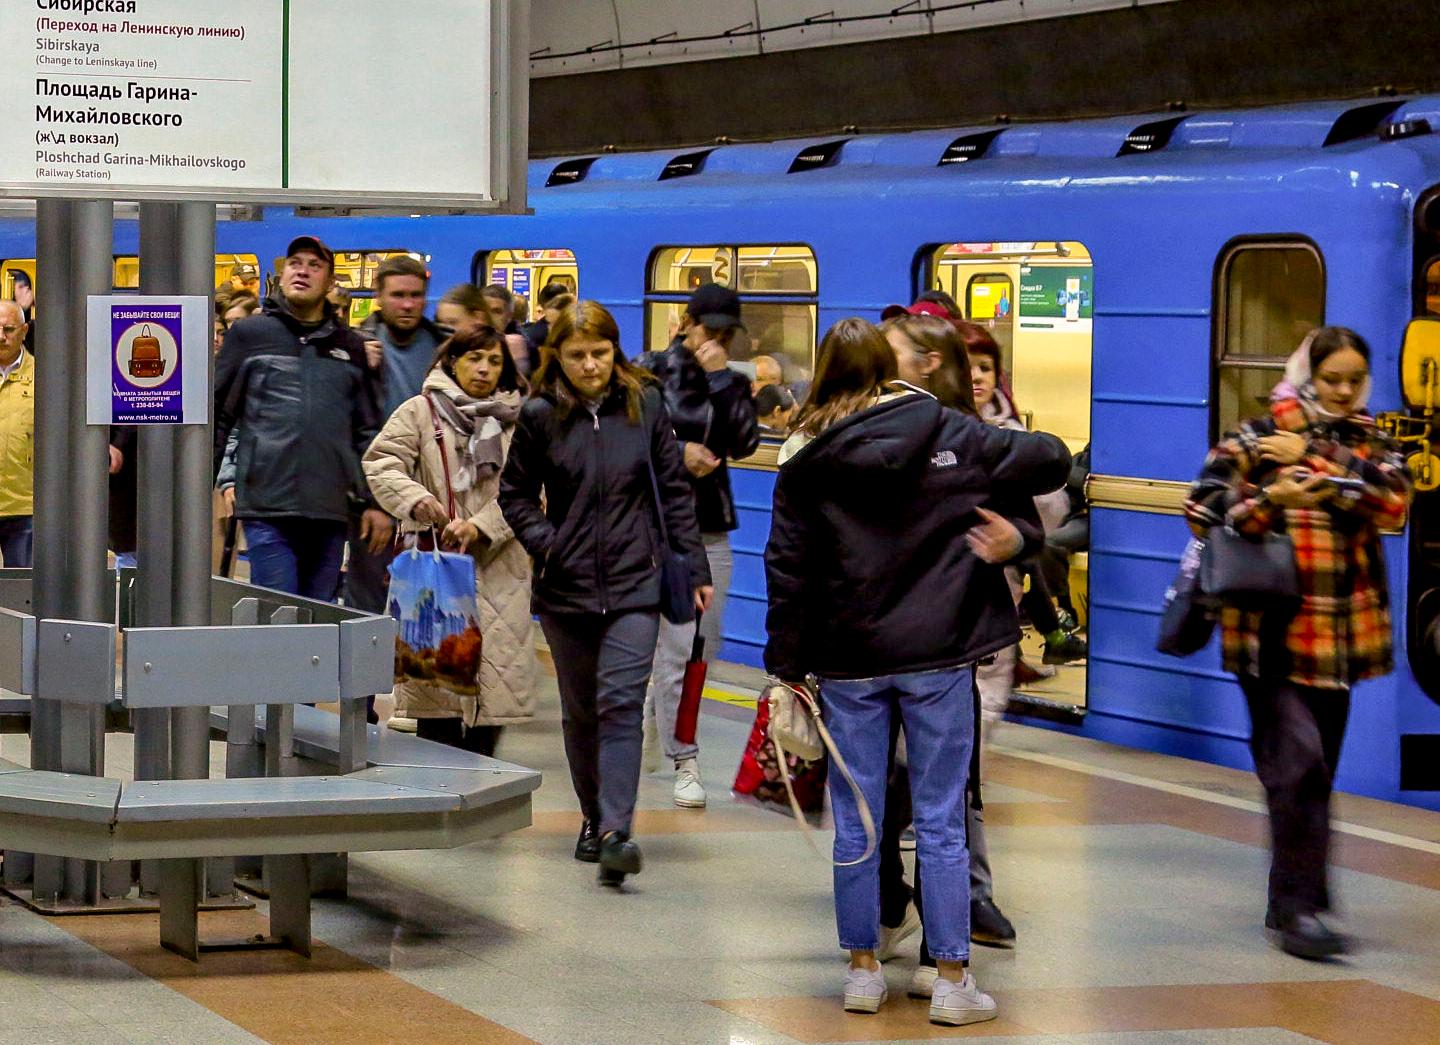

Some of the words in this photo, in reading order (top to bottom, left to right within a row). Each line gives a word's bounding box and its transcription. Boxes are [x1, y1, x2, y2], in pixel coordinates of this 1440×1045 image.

[36, 0, 136, 15] Сибирская
[36, 17, 99, 33] (Переход
[102, 23, 117, 33] на
[120, 21, 194, 38] Ленинскую
[197, 26, 245, 41] линию)
[36, 38, 100, 54] Sibirskaya
[36, 55, 72, 66] (Change
[74, 57, 84, 66] to
[85, 57, 135, 69] Leninskaya
[137, 59, 157, 70] line)
[36, 79, 122, 100] Площадь
[127, 82, 198, 103] Гарина-
[36, 105, 183, 126] Михайловского
[35, 130, 66, 145] (ж\д
[69, 133, 119, 147] вокзал)
[36, 151, 100, 164] Ploshchad
[104, 153, 246, 171] Garina-Mikhailovskogo
[35, 168, 74, 179] (Railway
[76, 170, 111, 180] Station)
